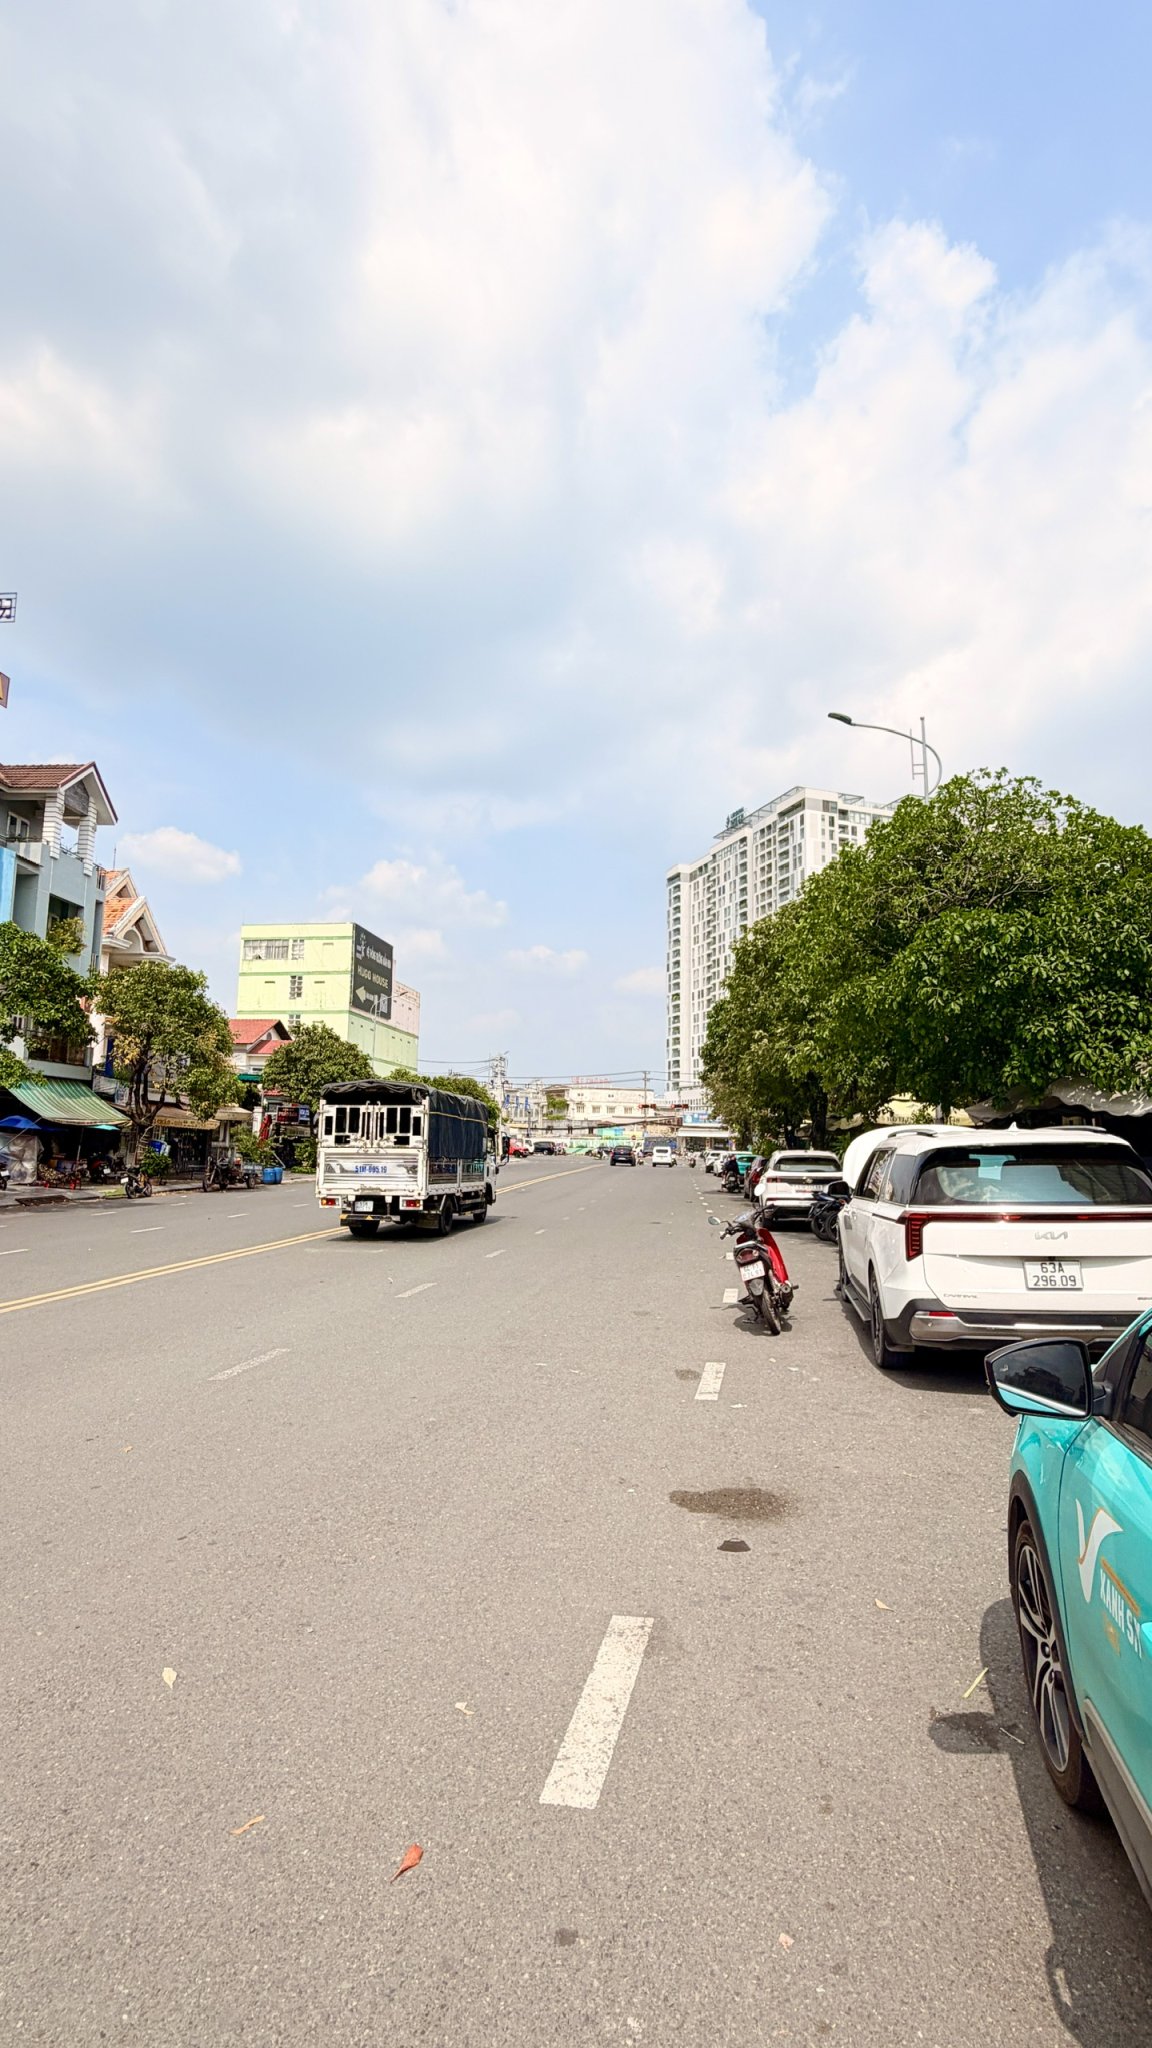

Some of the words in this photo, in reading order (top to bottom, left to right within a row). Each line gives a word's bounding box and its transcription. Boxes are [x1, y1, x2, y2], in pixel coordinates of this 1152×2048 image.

[1034, 1231, 1068, 1240] KIA
[1040, 1262, 1065, 1273] 63A
[1032, 1275, 1077, 1287] 296.09
[1100, 1567, 1125, 1634] XANH
